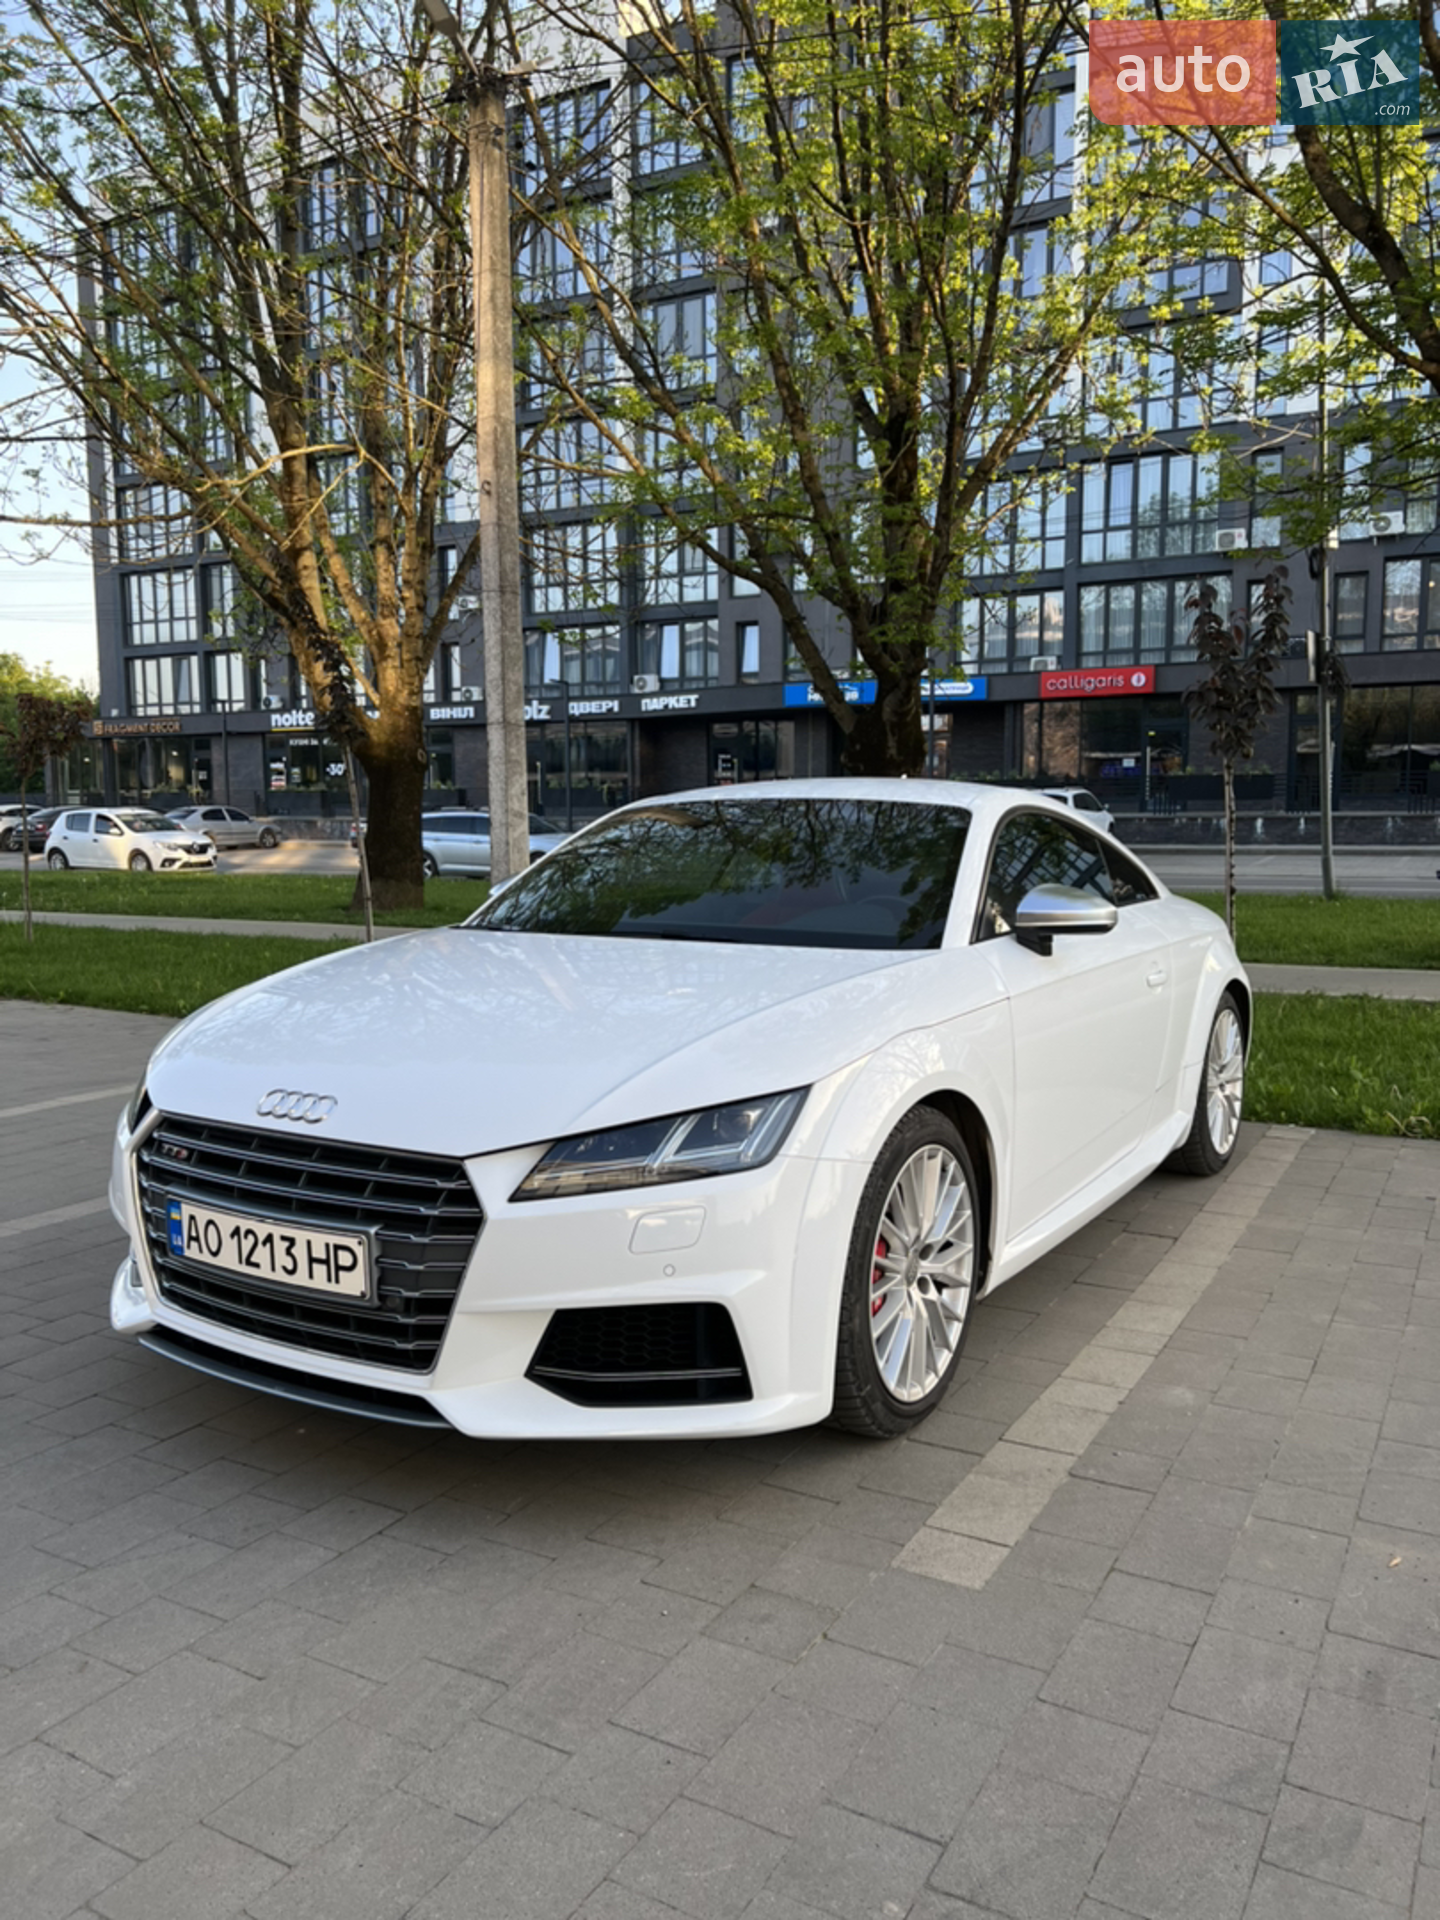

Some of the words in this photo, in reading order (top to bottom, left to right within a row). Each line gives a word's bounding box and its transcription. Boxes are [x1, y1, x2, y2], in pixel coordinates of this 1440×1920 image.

[1045, 675, 1124, 693] calligaris
[429, 706, 475, 720] ВІНІЛ
[568, 700, 619, 716] ДВЕРІ
[641, 694, 699, 712] ПАРКЕТ
[270, 709, 315, 727] nolte
[326, 763, 346, 776] -30
[186, 1213, 222, 1258] AO
[229, 1225, 298, 1276] 1213
[306, 1238, 359, 1285] HP
